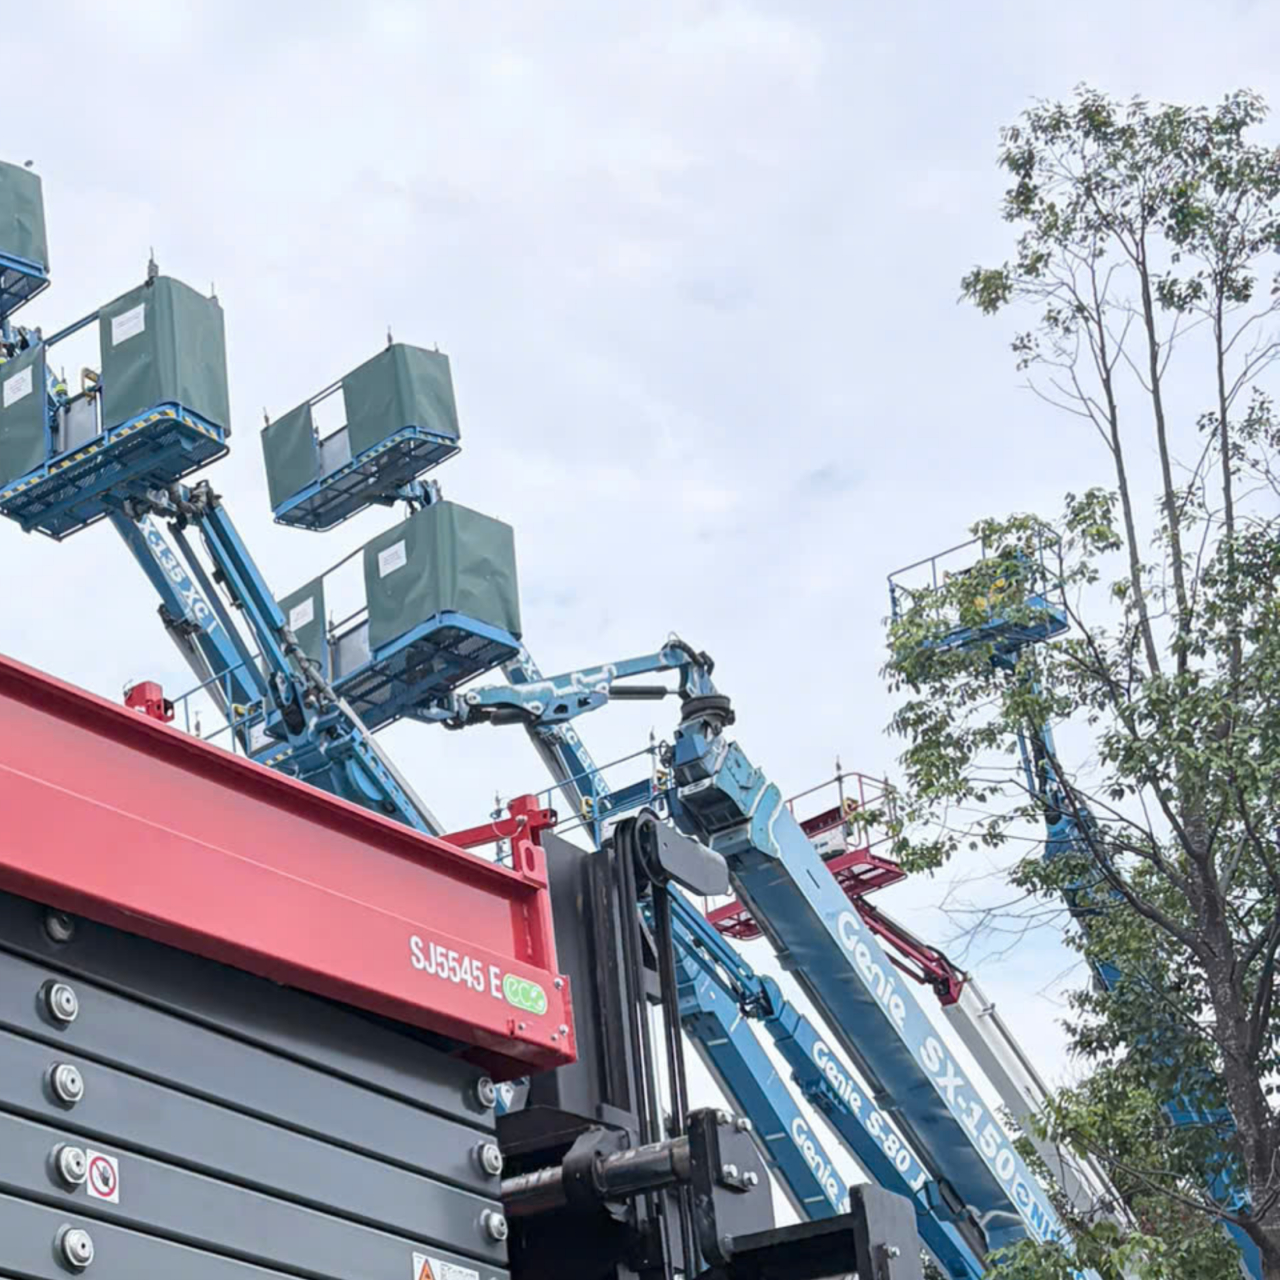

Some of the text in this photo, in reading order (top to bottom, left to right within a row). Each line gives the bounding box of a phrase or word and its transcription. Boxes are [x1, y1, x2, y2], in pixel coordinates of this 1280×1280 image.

[410, 935, 503, 1000] SJ5545 E
[837, 910, 1016, 1181] Genie SX-150
[813, 1041, 862, 1117] Genie
[866, 1111, 912, 1172] S-80
[791, 1117, 840, 1208] Genie
